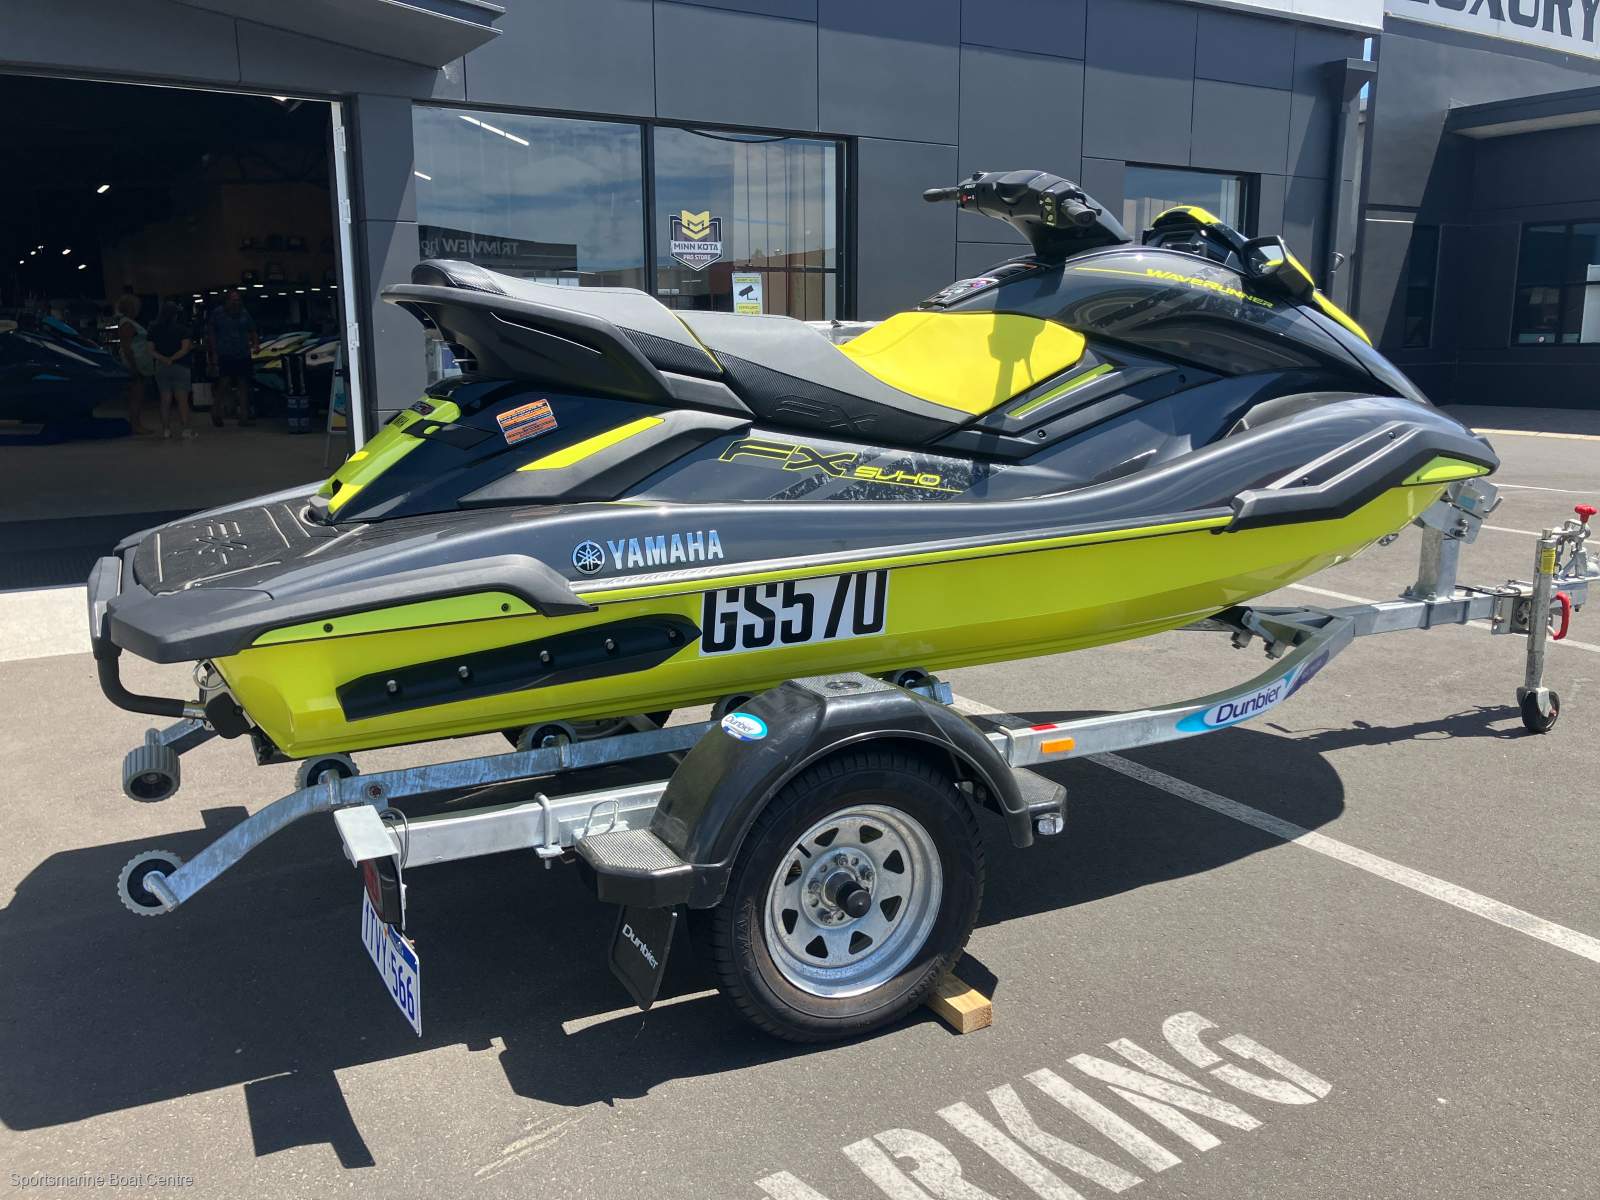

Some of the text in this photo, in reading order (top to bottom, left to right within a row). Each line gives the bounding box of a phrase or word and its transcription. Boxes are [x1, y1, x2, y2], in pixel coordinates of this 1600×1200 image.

[1147, 268, 1274, 309] WAVERUNNER
[719, 437, 858, 477] FX
[607, 529, 724, 570] YAMAHA
[724, 715, 755, 732] Dunbier
[1215, 685, 1282, 724] Dunbier
[622, 923, 659, 969] Dunbier
